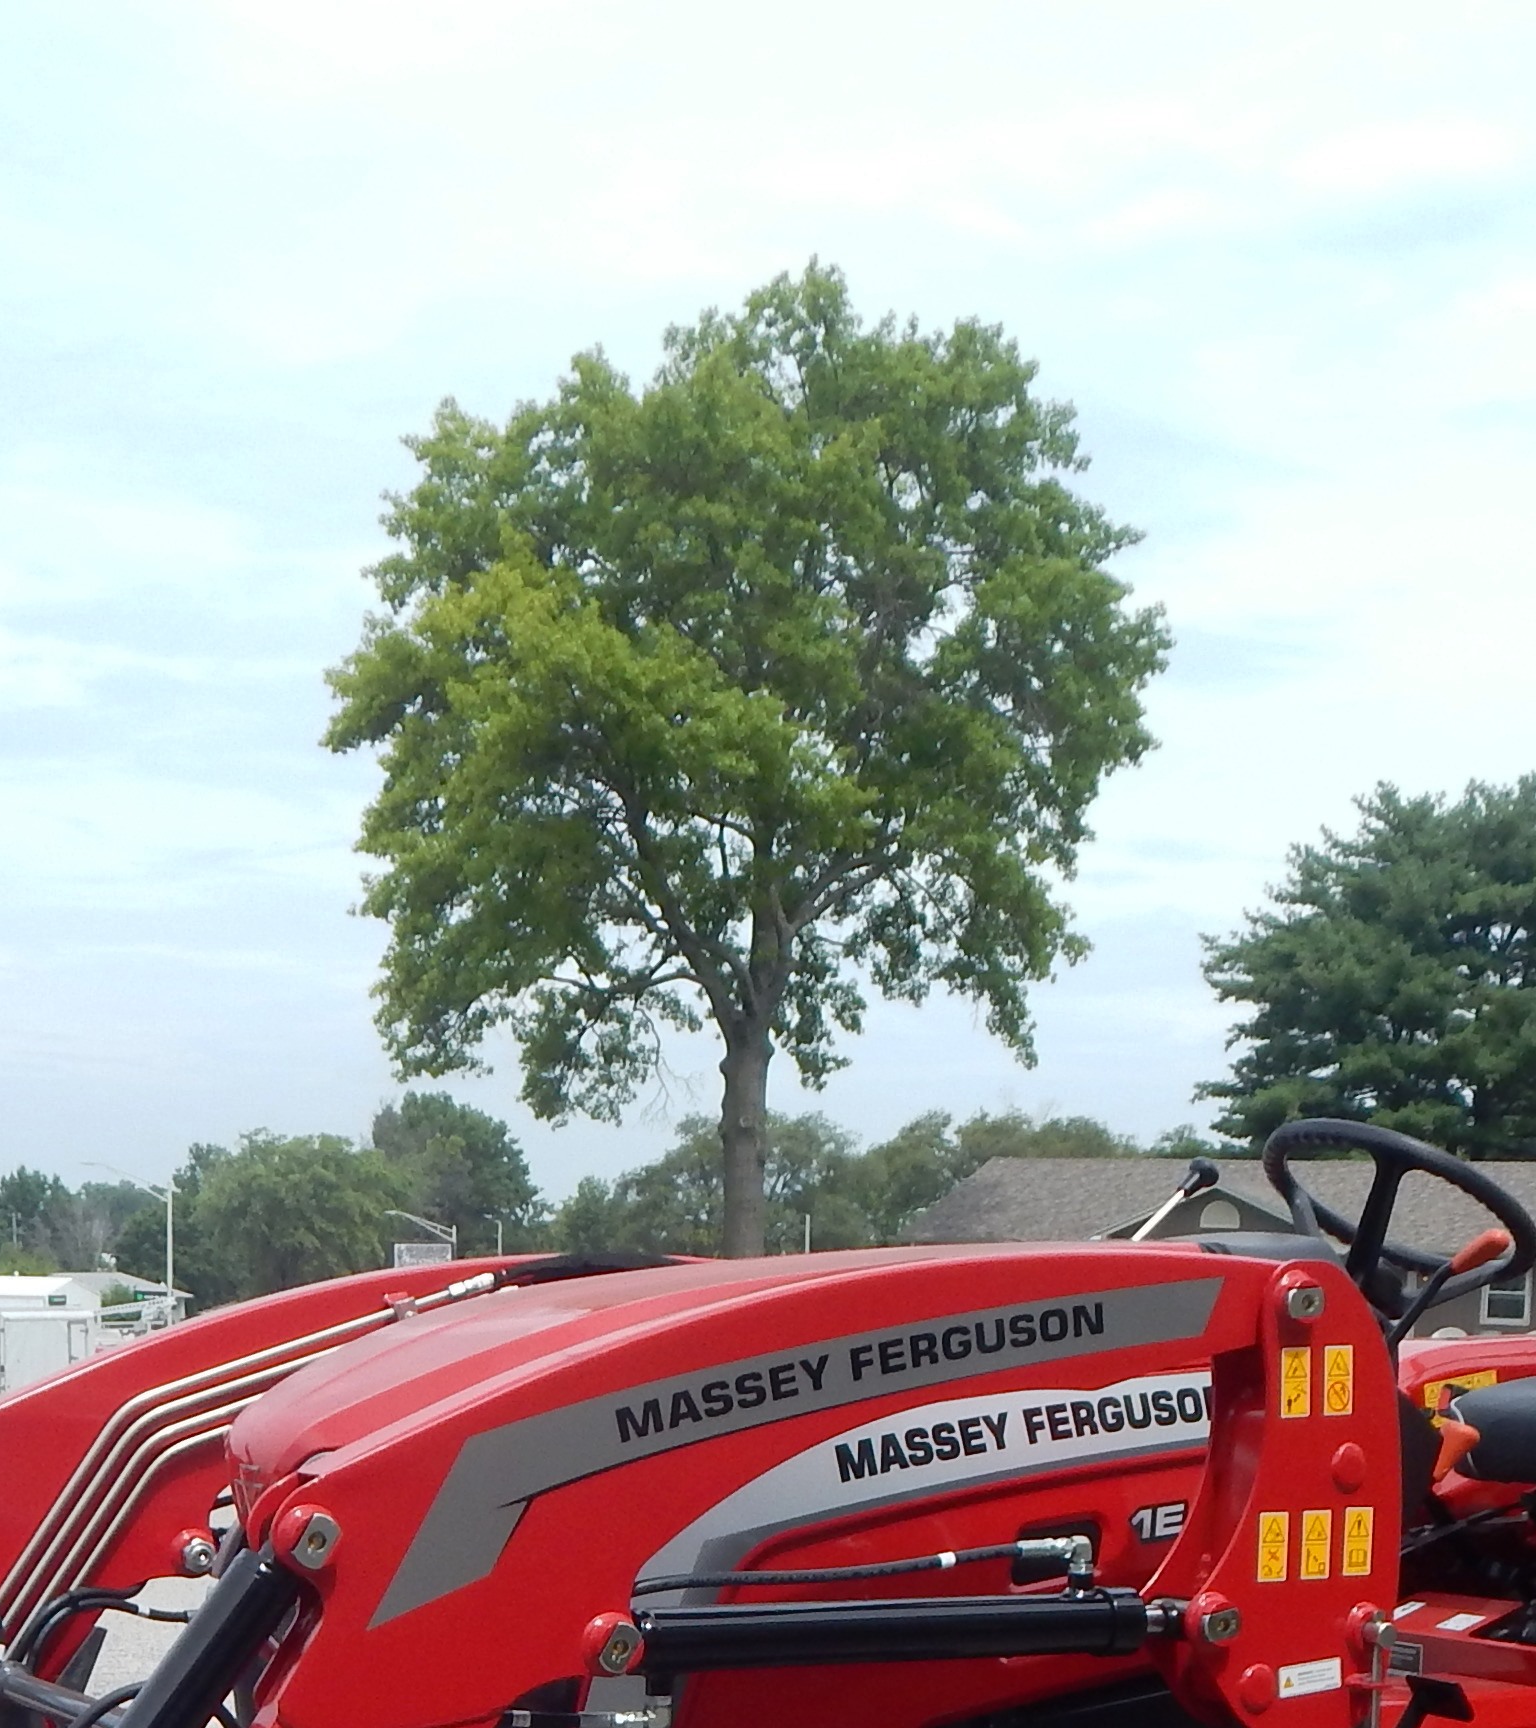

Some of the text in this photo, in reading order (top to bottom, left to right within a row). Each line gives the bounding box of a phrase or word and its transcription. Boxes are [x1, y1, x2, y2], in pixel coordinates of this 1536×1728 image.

[615, 1302, 1105, 1444] MASSEY FERGUSON
[834, 1386, 1212, 1483] MASSEY FERGUSO
[1130, 1502, 1186, 1540] 1E
